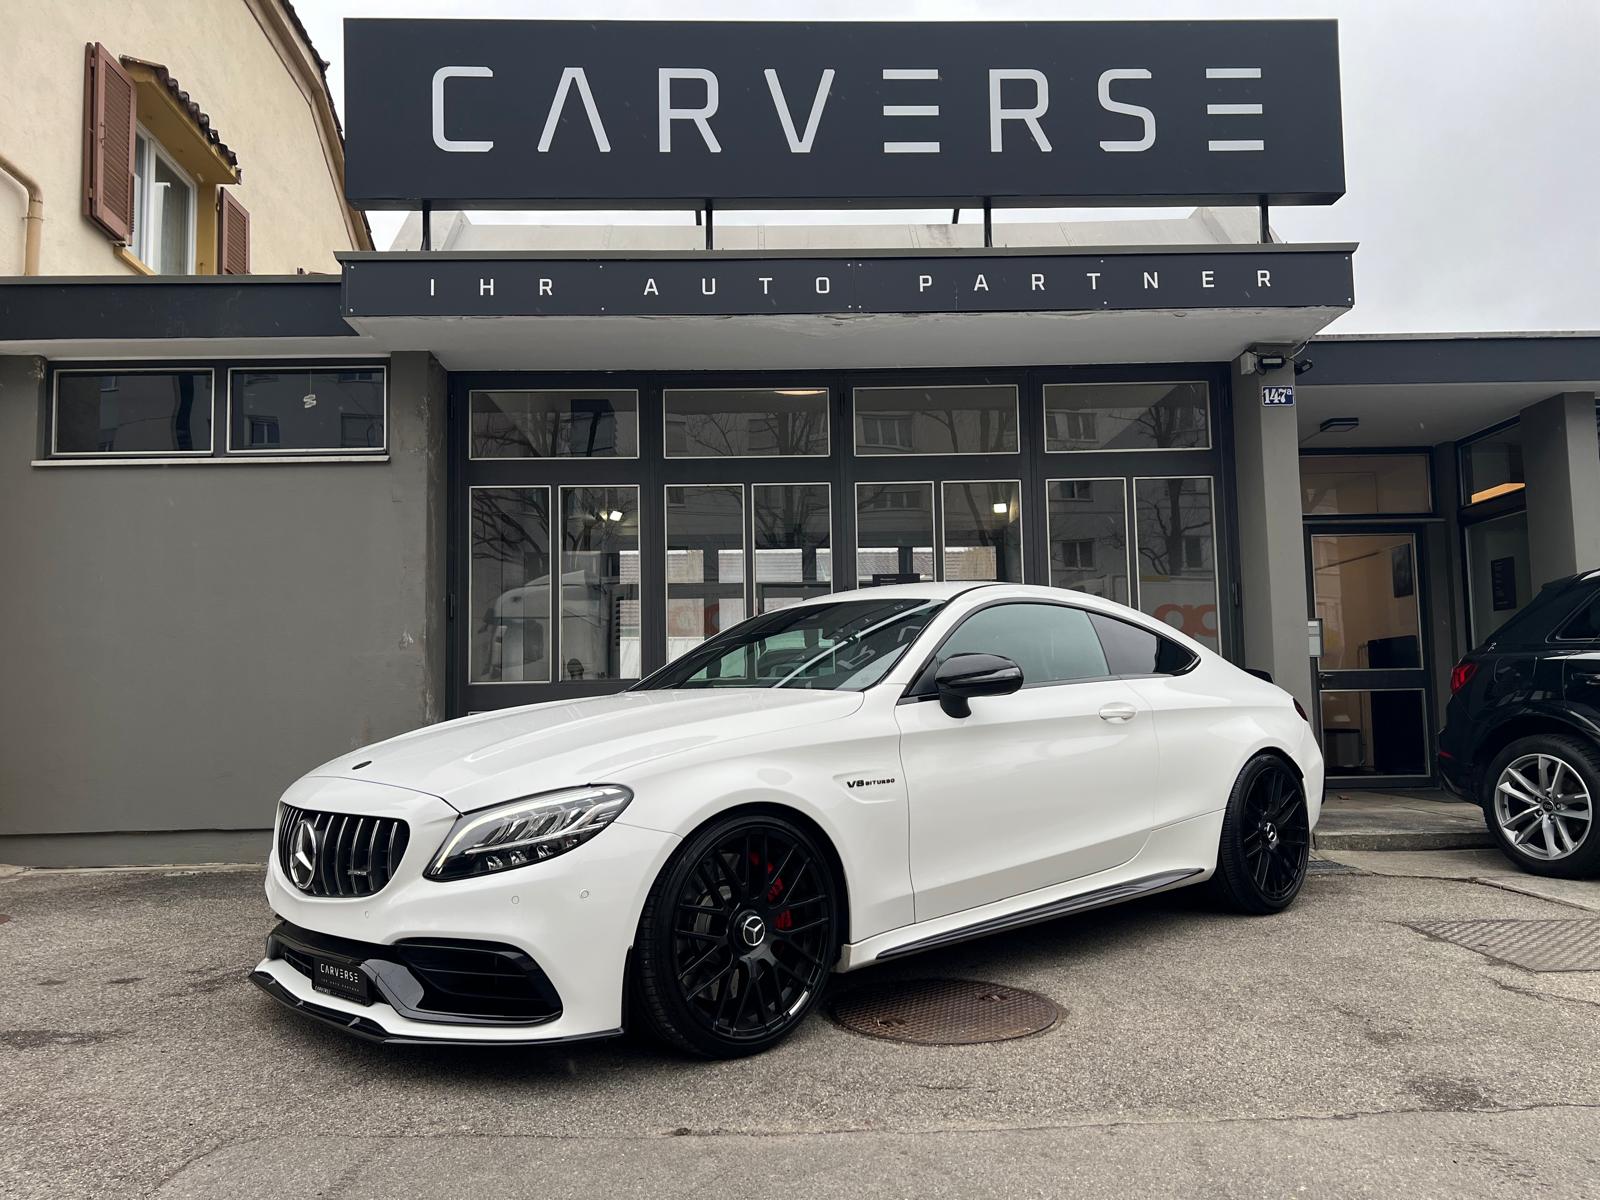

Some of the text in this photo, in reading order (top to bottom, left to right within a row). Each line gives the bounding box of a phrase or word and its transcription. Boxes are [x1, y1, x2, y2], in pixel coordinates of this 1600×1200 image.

[431, 65, 1265, 154] CARVERSE
[430, 269, 1271, 297] IHR AUTO PARTNER
[846, 780, 865, 788] V8
[320, 963, 359, 983] CARVERSE
